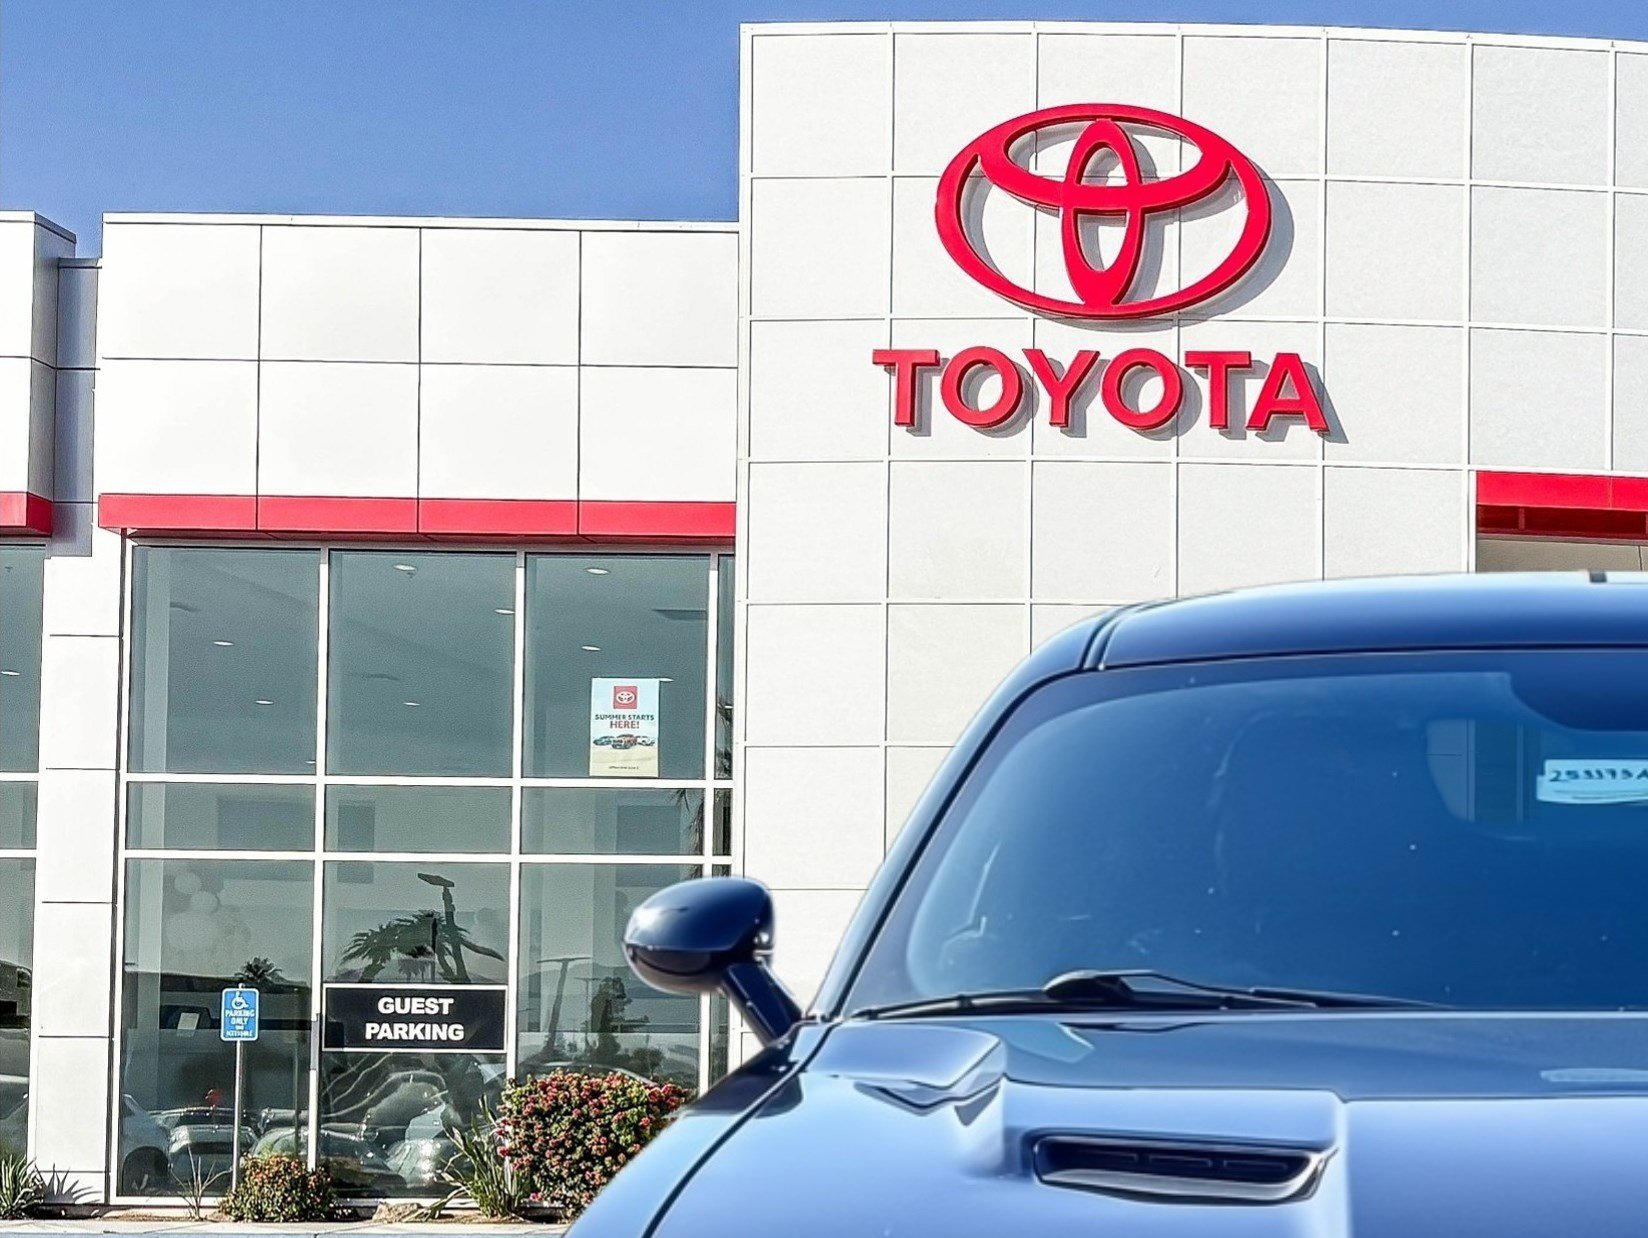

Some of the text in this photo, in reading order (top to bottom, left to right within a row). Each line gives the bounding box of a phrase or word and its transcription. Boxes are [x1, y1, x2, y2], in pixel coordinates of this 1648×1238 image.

[873, 346, 1330, 433] TOYOTA
[610, 721, 640, 729] HERE!
[377, 997, 454, 1014] GUEST
[365, 1023, 465, 1041] PARKING
